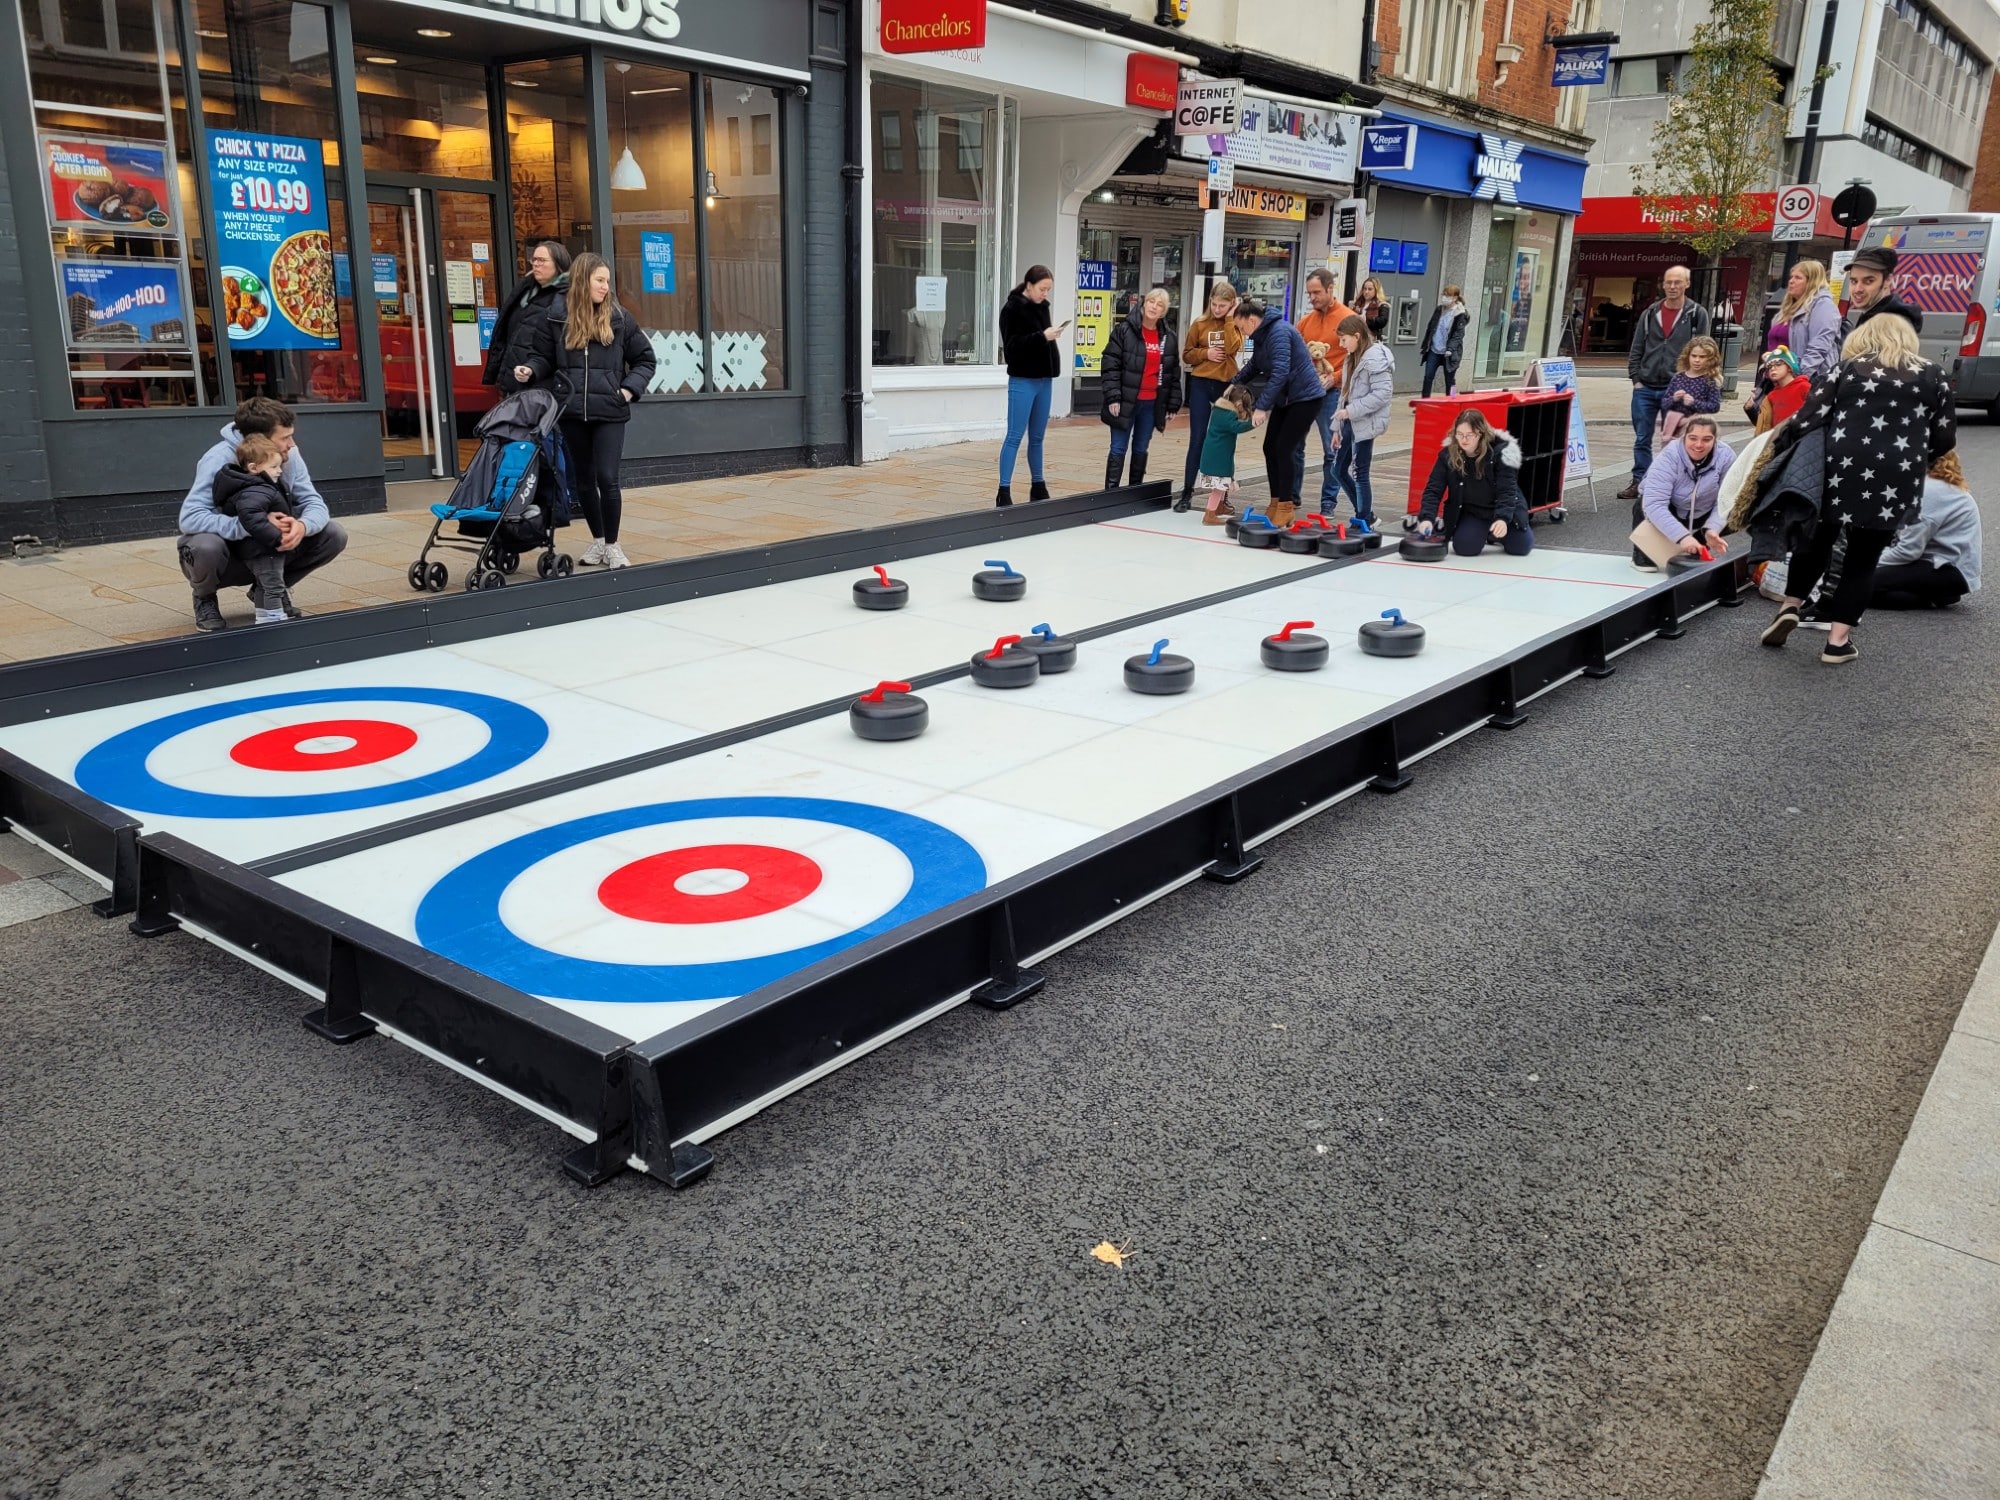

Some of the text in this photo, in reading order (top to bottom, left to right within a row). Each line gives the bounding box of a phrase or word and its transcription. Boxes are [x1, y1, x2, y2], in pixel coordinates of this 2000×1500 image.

[885, 12, 971, 42] Chancellors
[1555, 60, 1604, 72] HALIFAX
[1136, 83, 1175, 103] Chancellors
[1180, 86, 1236, 100] INTERNET
[1179, 100, 1235, 127] C@FÉ
[1241, 103, 1261, 131] air
[214, 137, 253, 156] CHICK
[272, 143, 306, 161] PIZZA
[51, 151, 85, 164] COOKIES
[54, 163, 108, 177] AFTER EIGHT
[218, 158, 298, 175] ANY SIZE PIZZA
[1211, 160, 1217, 171] P
[1476, 154, 1523, 183] HALIFAX
[218, 171, 243, 181] for just
[231, 176, 309, 213] £10.99
[1261, 192, 1294, 213] SHOP
[1784, 197, 1810, 211] 30
[223, 211, 286, 223] WHEN YOU BUY
[225, 222, 273, 232] ANY 7 PIECE
[225, 231, 282, 242] CHICKEN SIDE
[645, 242, 671, 253] DRIVERS
[645, 252, 671, 263] WANTED
[1579, 252, 1688, 263] British Heart Foundation
[1087, 263, 1105, 273] WILL
[1079, 273, 1104, 288] IX IT!
[1917, 273, 1975, 291] CREW
